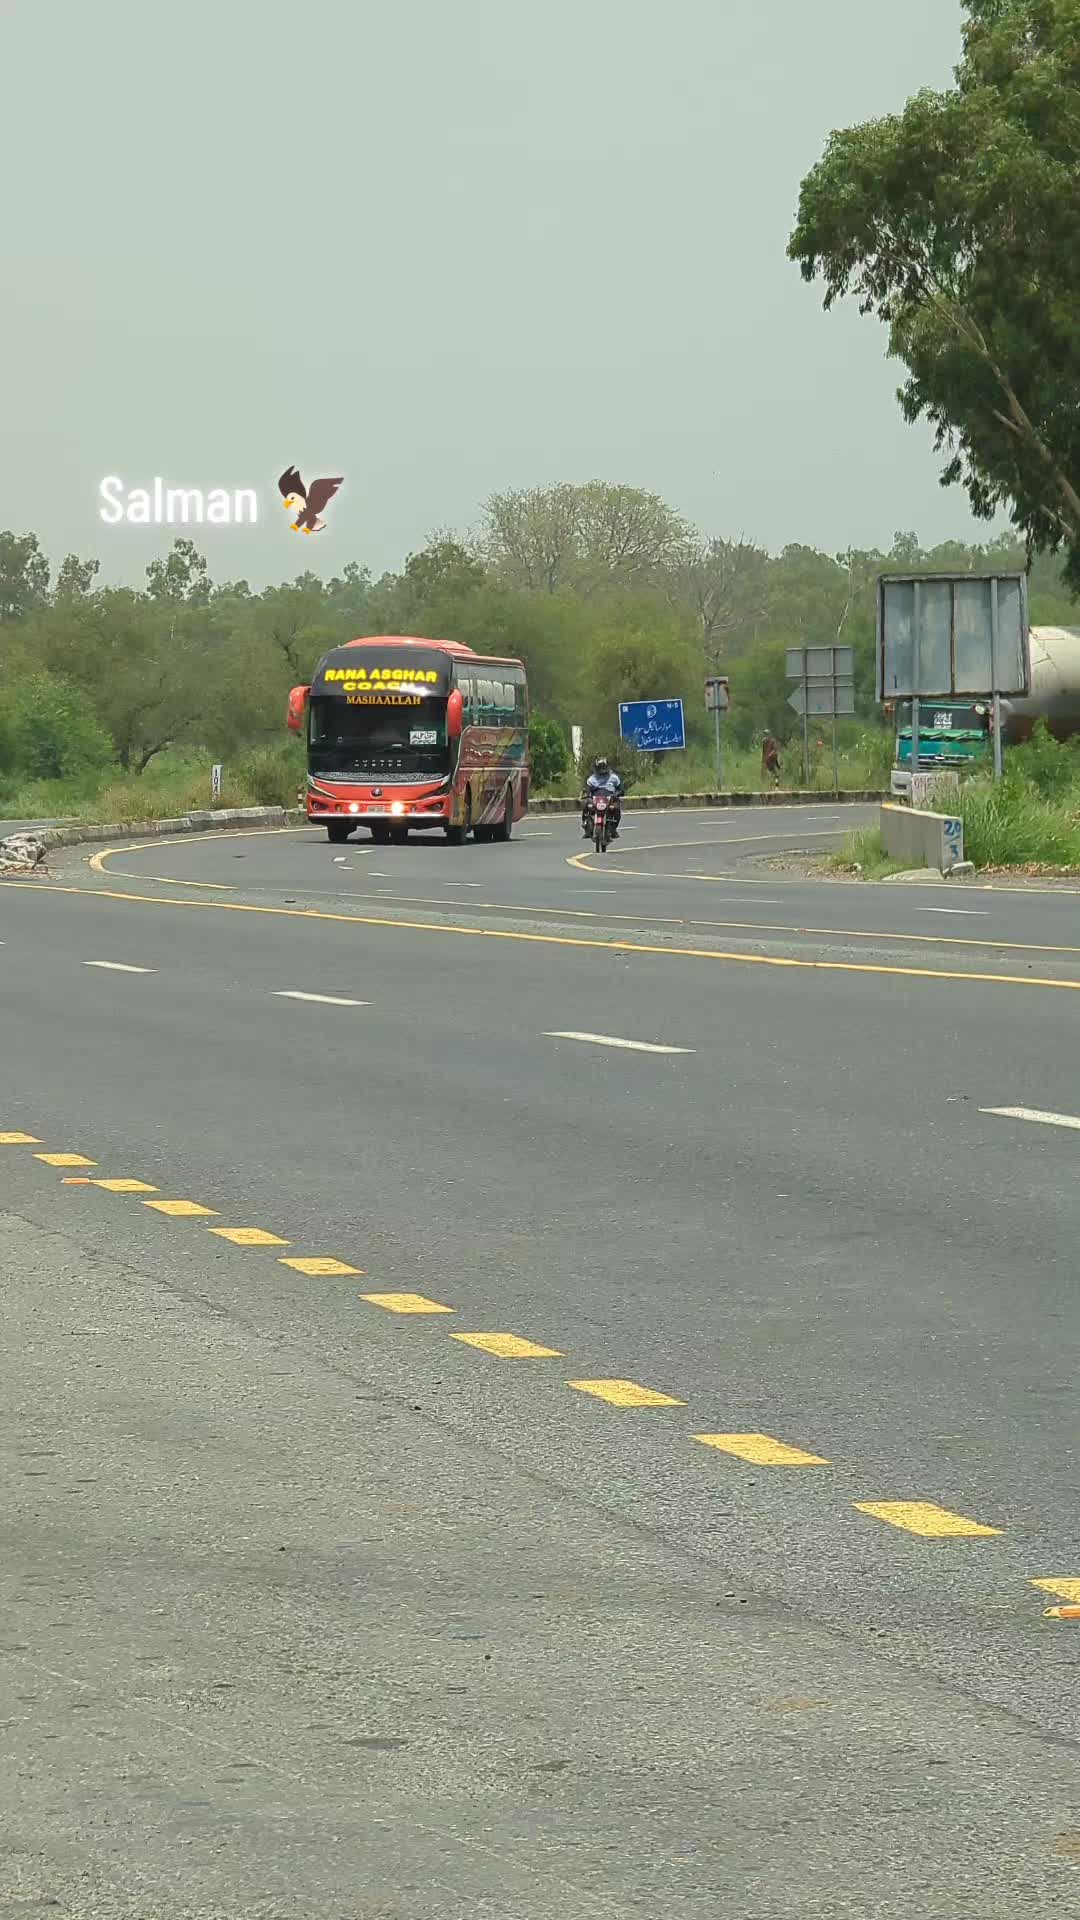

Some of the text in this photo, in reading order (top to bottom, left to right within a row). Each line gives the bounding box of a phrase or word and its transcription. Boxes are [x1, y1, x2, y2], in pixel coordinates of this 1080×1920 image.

[324, 669, 438, 683] RANA ASGHAR
[346, 695, 421, 705] MASHAALLAH
